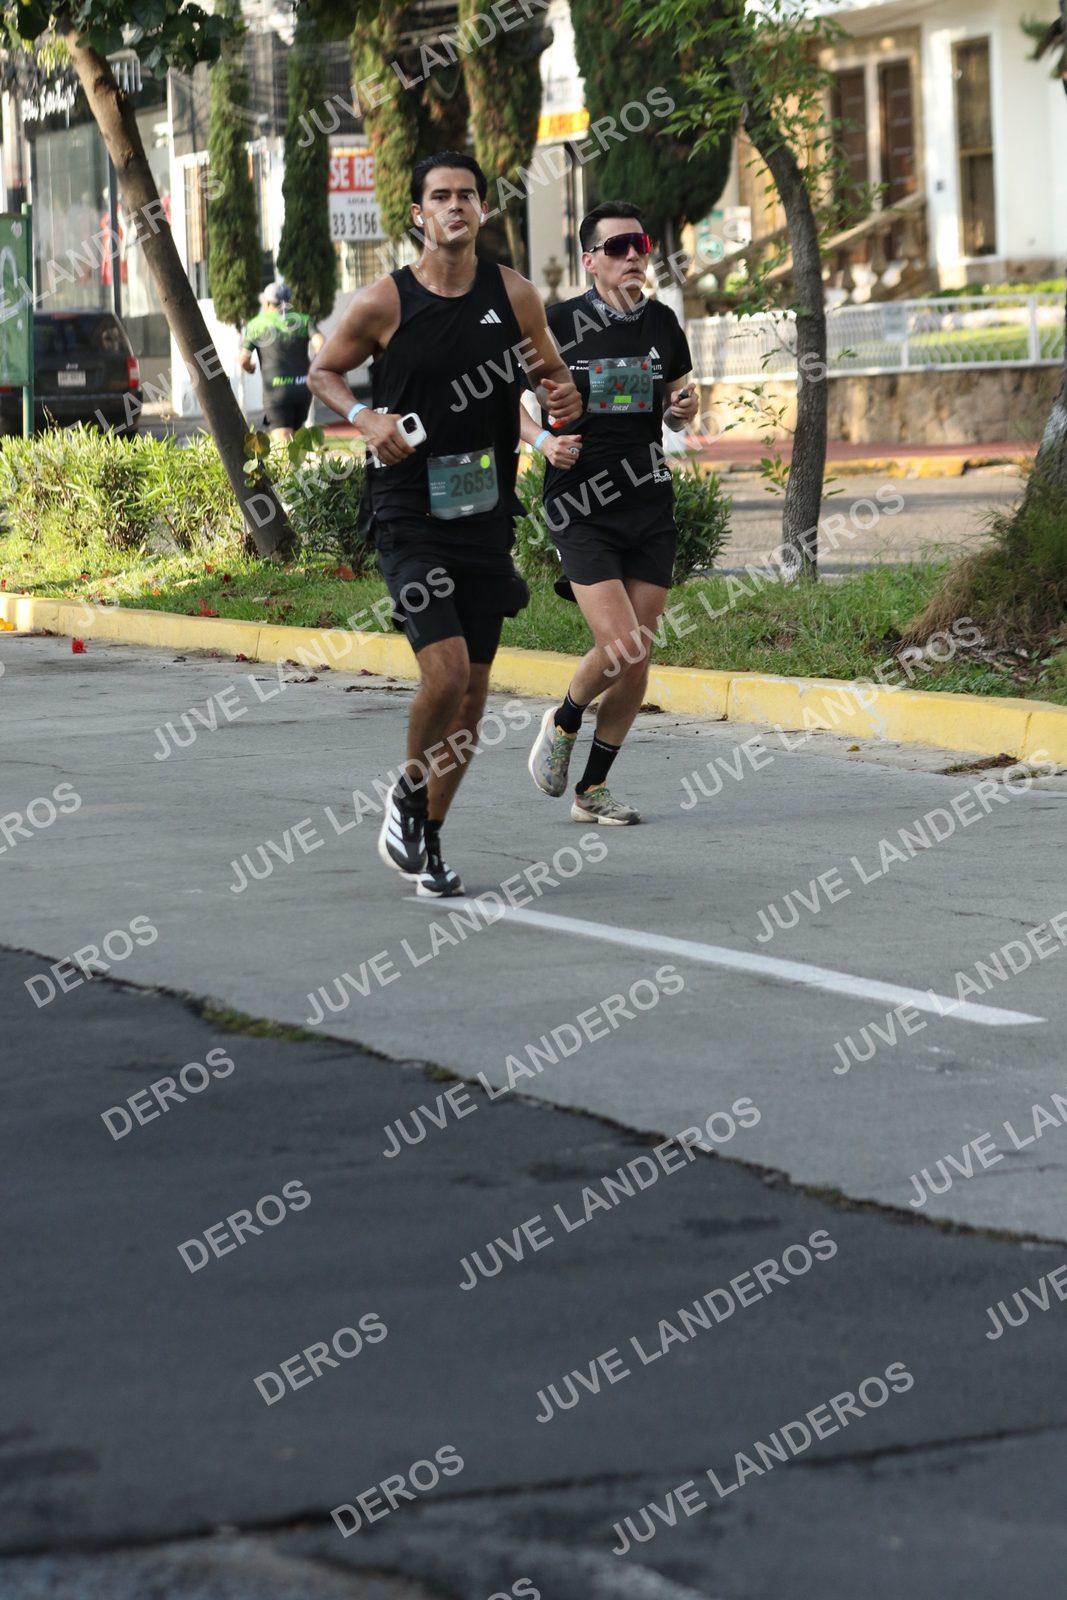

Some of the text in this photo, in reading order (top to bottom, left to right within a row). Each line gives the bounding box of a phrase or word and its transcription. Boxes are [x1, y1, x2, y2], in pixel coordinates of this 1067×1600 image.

[329, 157, 350, 189] SE
[332, 212, 378, 236] 33 3156
[272, 375, 294, 387] RUN
[607, 373, 651, 396] 2729
[449, 469, 495, 498] 2653
